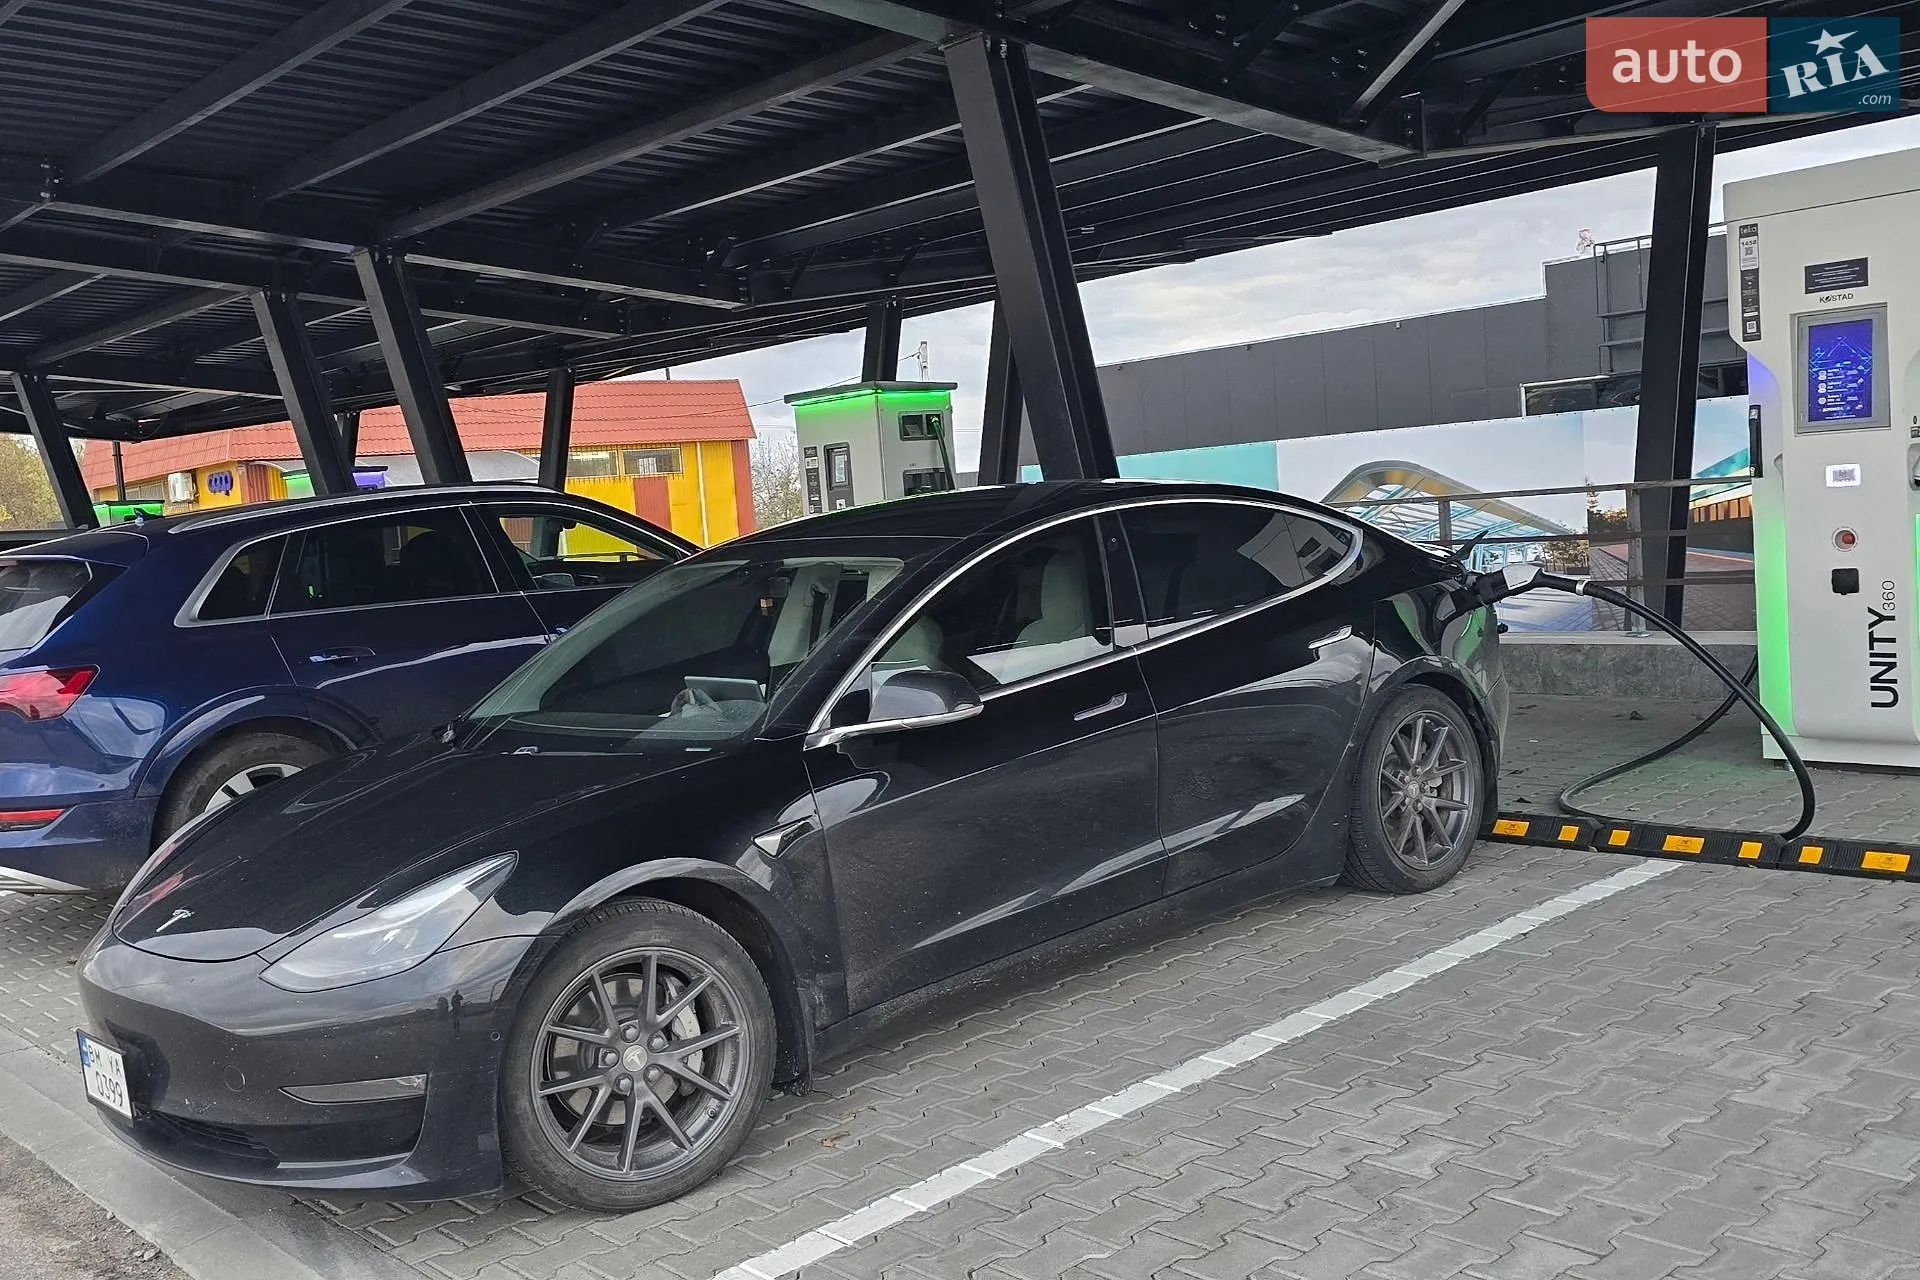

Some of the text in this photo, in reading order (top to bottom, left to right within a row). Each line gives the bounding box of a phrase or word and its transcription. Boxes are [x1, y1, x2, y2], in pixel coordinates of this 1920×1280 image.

[1867, 580, 1899, 709] UNITY 360
[95, 1070, 123, 1107] 0399
